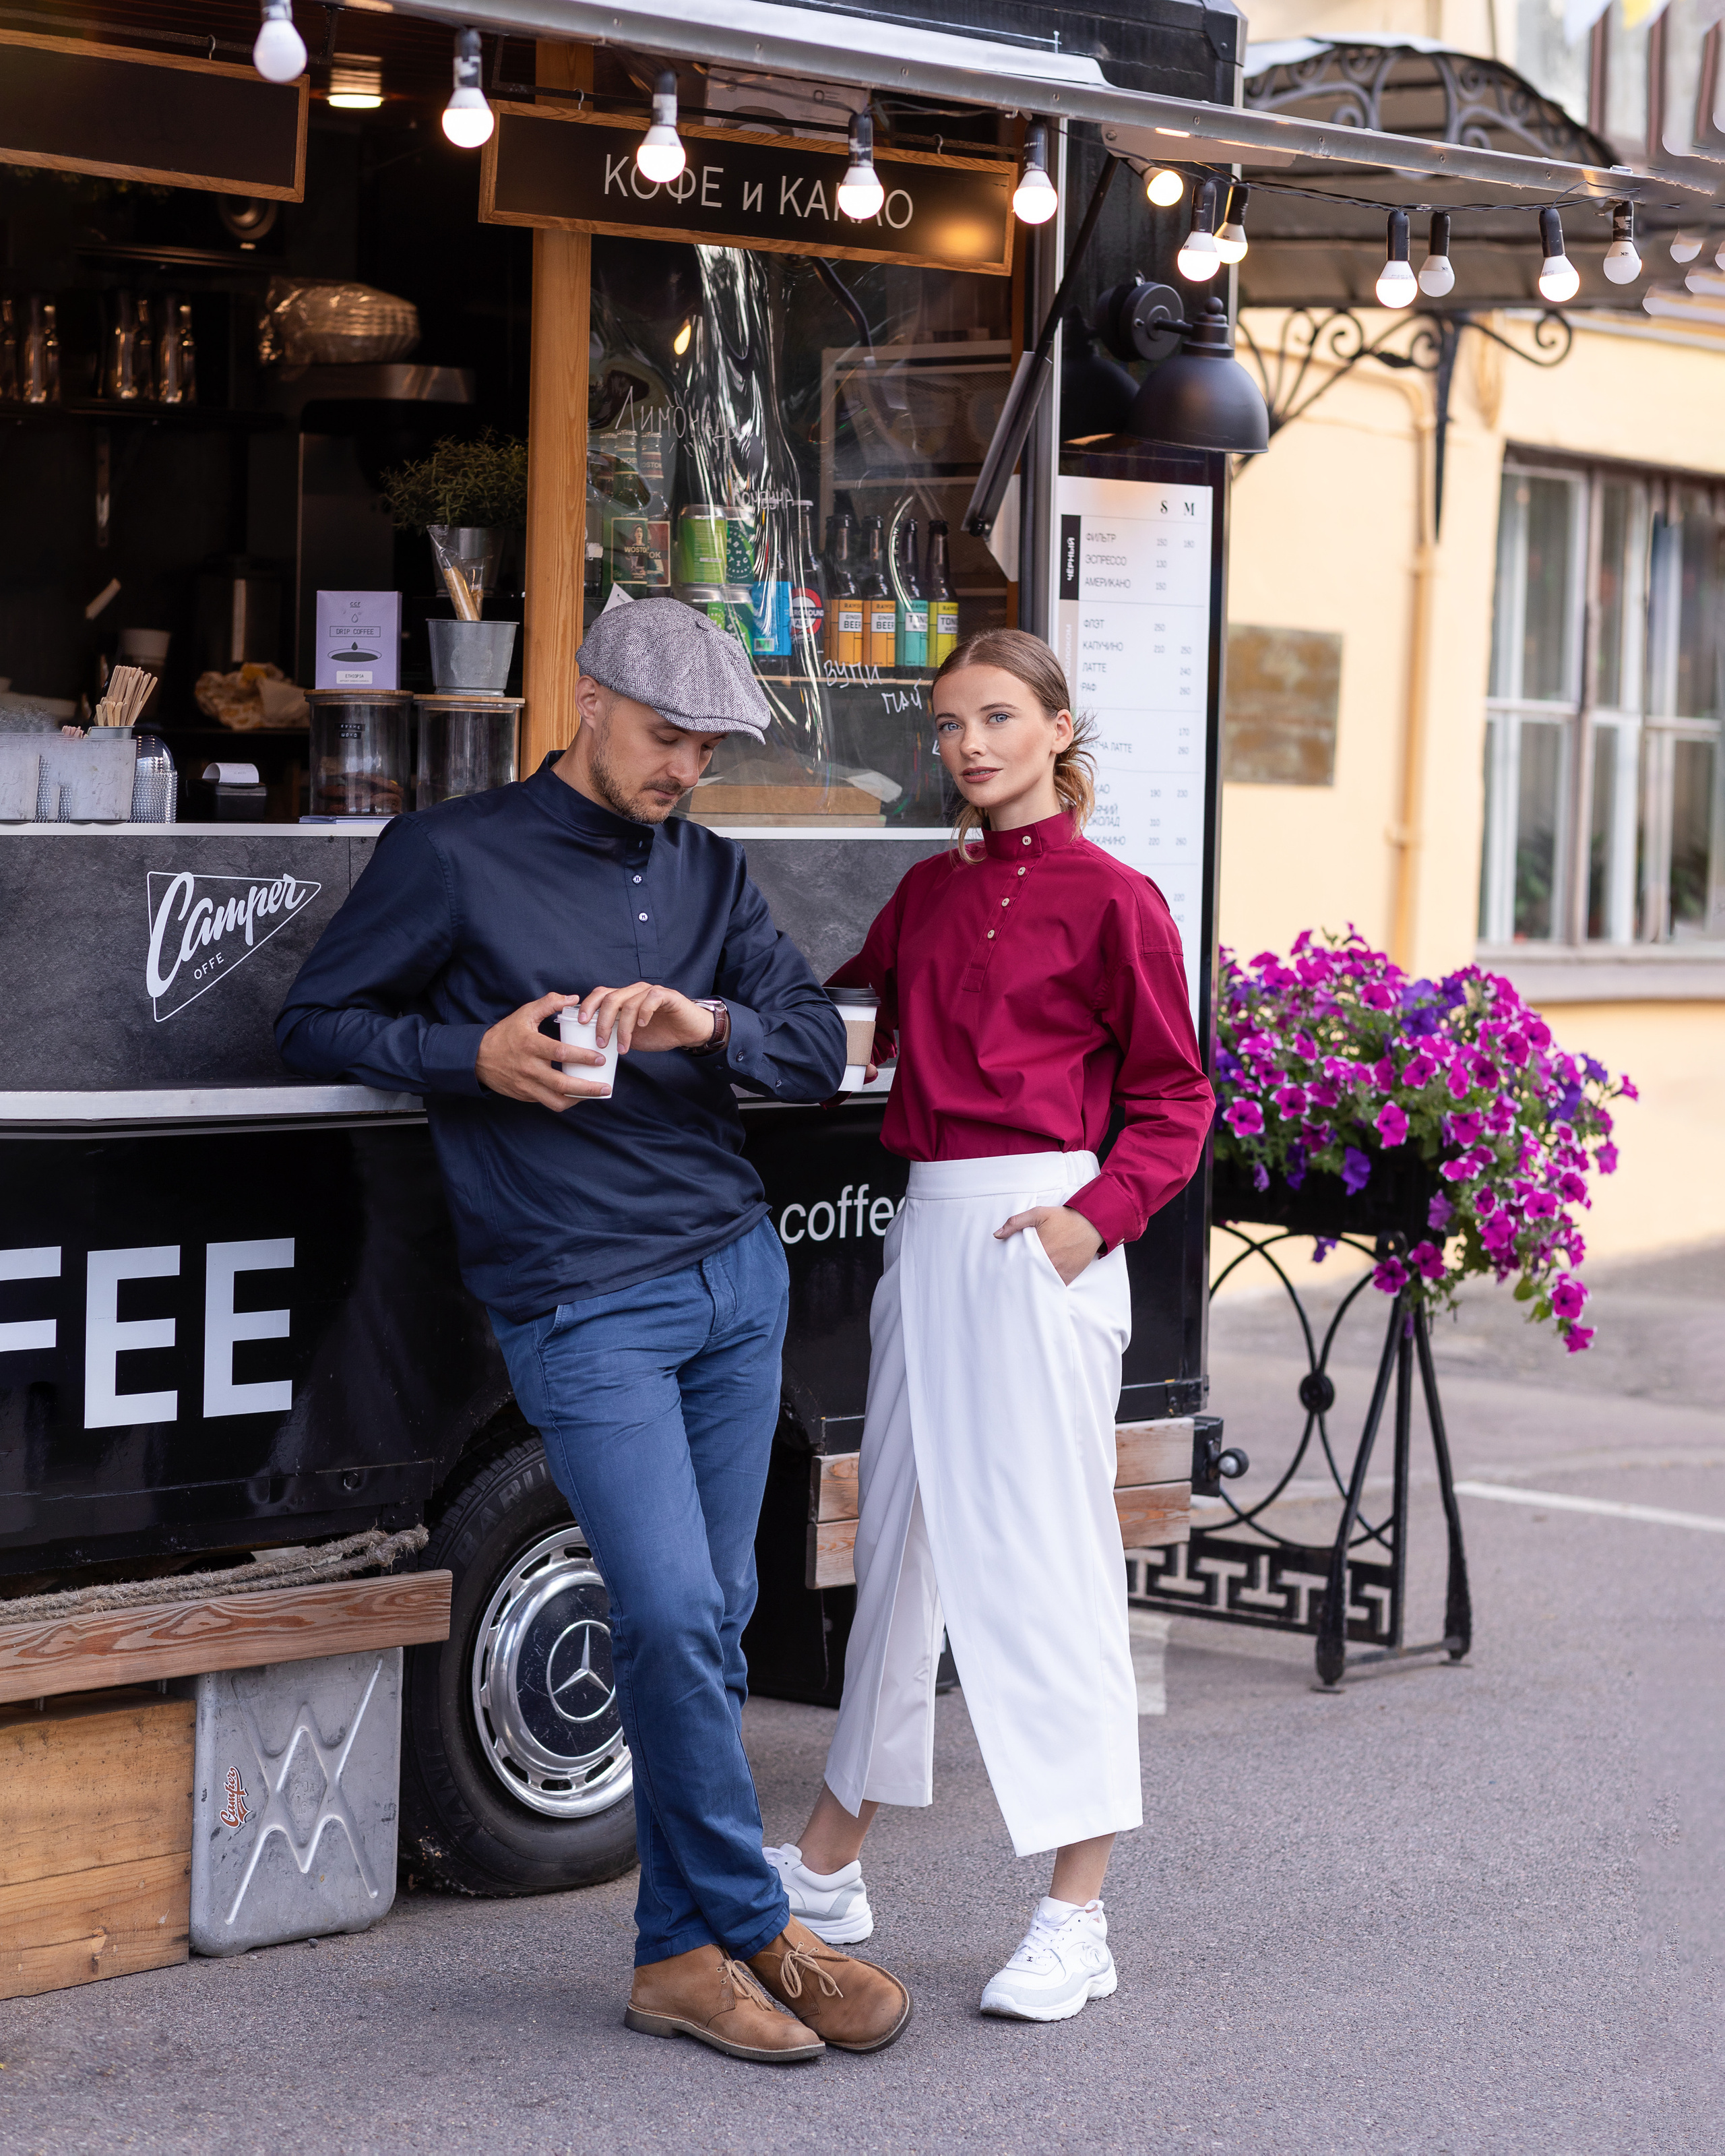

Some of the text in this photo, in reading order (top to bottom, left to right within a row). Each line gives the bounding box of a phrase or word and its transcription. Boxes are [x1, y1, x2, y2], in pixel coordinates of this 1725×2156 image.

[604, 154, 724, 208] КОФЕ
[778, 175, 913, 229] КАО
[1160, 500, 1195, 516] S M
[1086, 533, 1117, 543] ФИЛЬТР
[1085, 555, 1127, 565] ЭСПРЕССО
[1085, 578, 1131, 588] АМЕРИКАНО
[1083, 641, 1123, 651] КАПУЧИНО
[1082, 663, 1106, 673] ЛАТТЕ
[1094, 784, 1110, 795] КАО
[1087, 816, 1120, 827] ОКОЛАД
[1086, 836, 1126, 846] ОККАЧИНО
[146, 871, 306, 997] Camper
[193, 952, 225, 979] OFFE
[780, 1183, 906, 1244] coffe
[220, 1766, 247, 1828] Camper
[986, 1995, 1010, 2003] CHANEL
